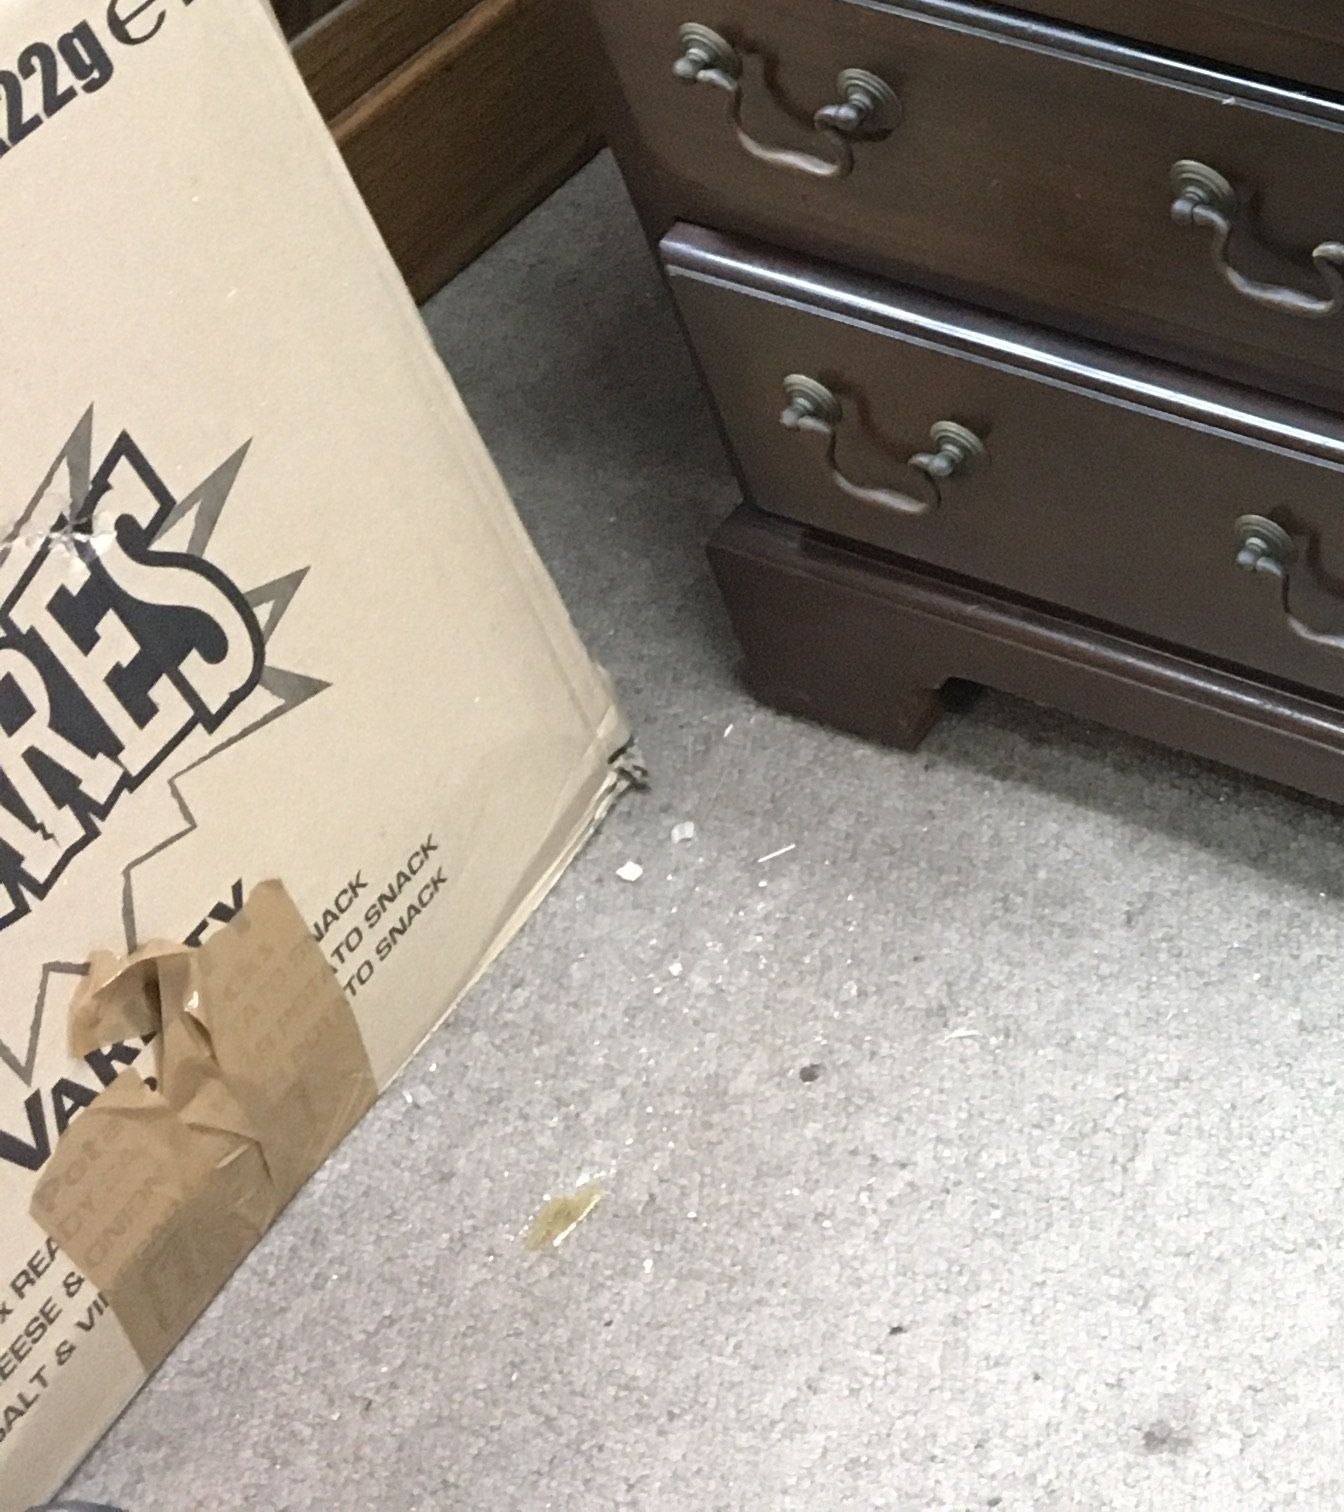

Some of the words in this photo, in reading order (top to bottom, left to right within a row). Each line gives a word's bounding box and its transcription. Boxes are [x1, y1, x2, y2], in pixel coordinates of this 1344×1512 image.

[55, 1340, 76, 1366] &
[375, 866, 448, 961] SNACK
[62, 1271, 85, 1298] &
[364, 833, 438, 929] SNACK
